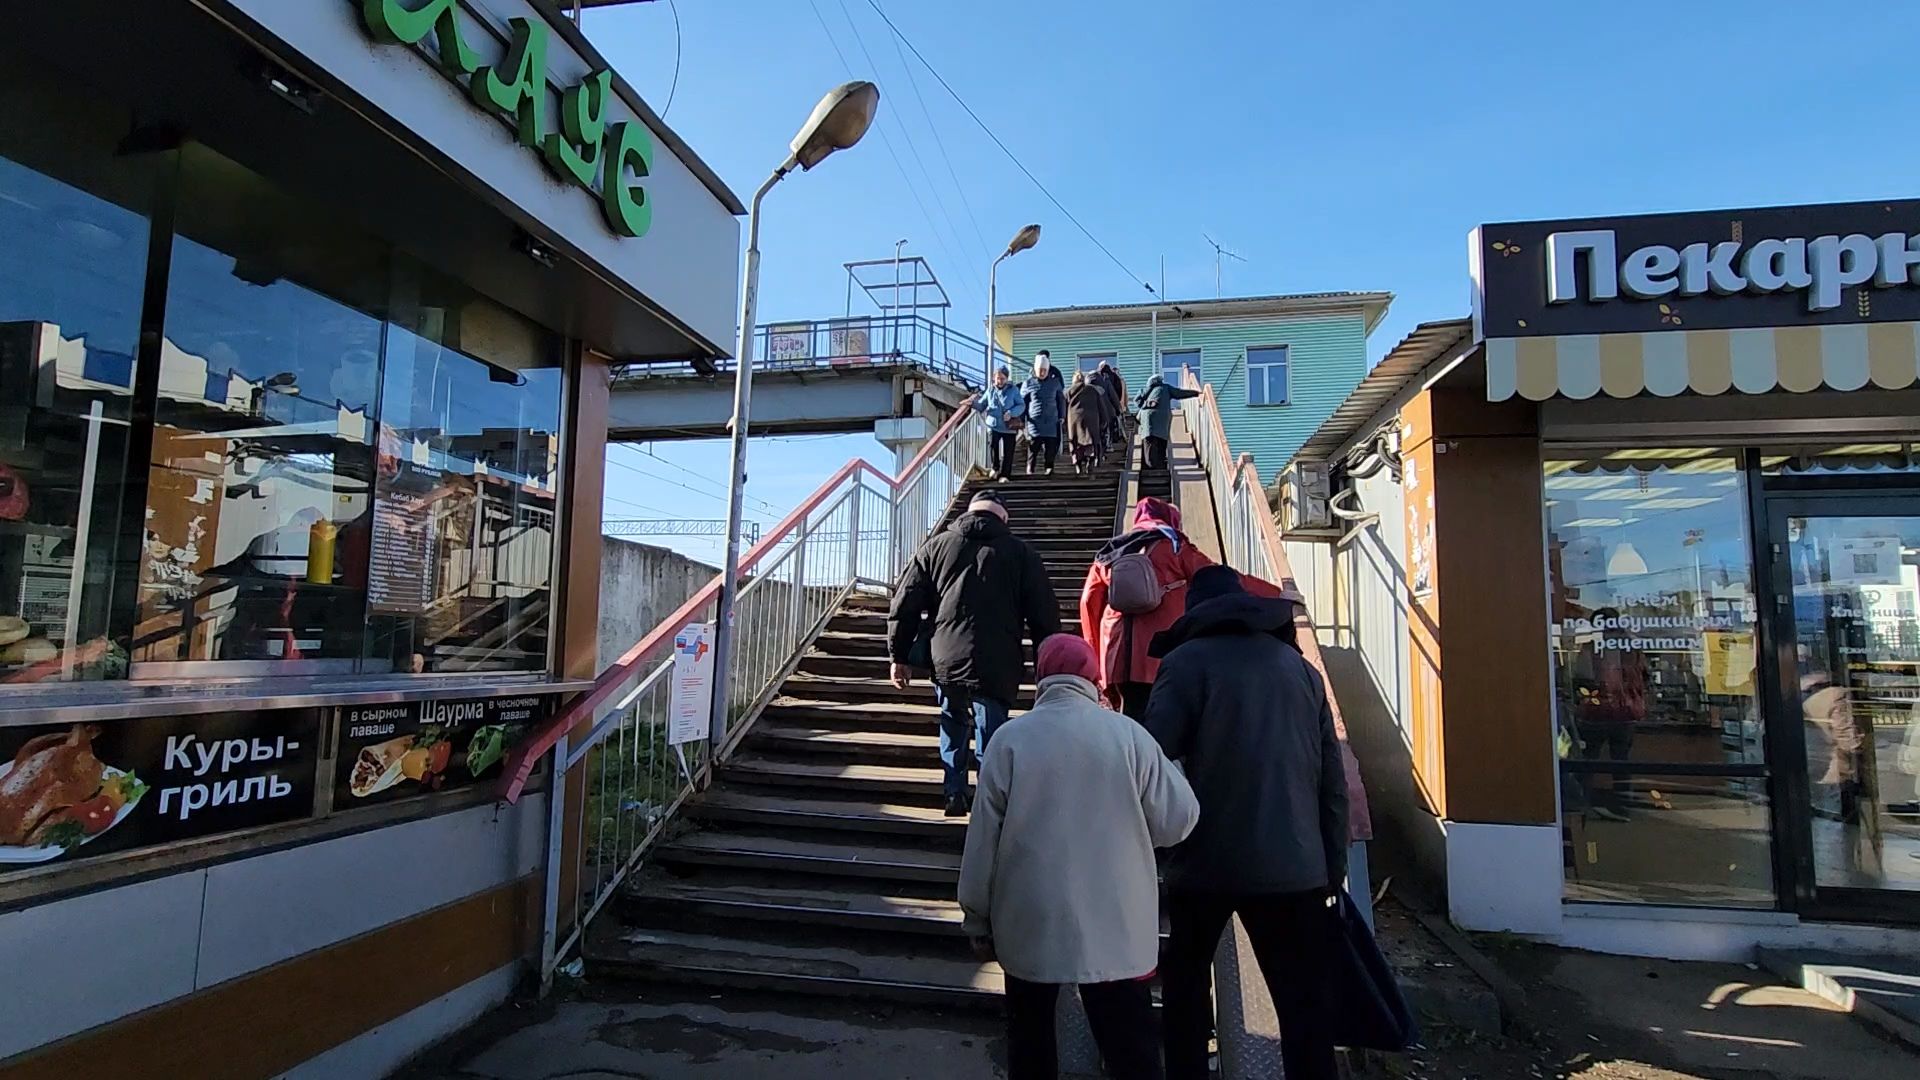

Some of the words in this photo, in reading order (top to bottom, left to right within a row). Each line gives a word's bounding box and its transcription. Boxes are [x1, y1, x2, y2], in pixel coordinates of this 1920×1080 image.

[1593, 613, 1733, 633] бабушкиным
[1593, 635, 1701, 653] рецептам
[489, 700, 494, 709] в
[497, 697, 540, 709] чесночном
[351, 712, 358, 721] в
[361, 707, 408, 722] сырном
[420, 700, 483, 727] Шаурма
[500, 709, 530, 720] лаваше
[350, 723, 395, 737] лаваше
[164, 734, 299, 776] Куры-
[159, 774, 292, 820] гриль
